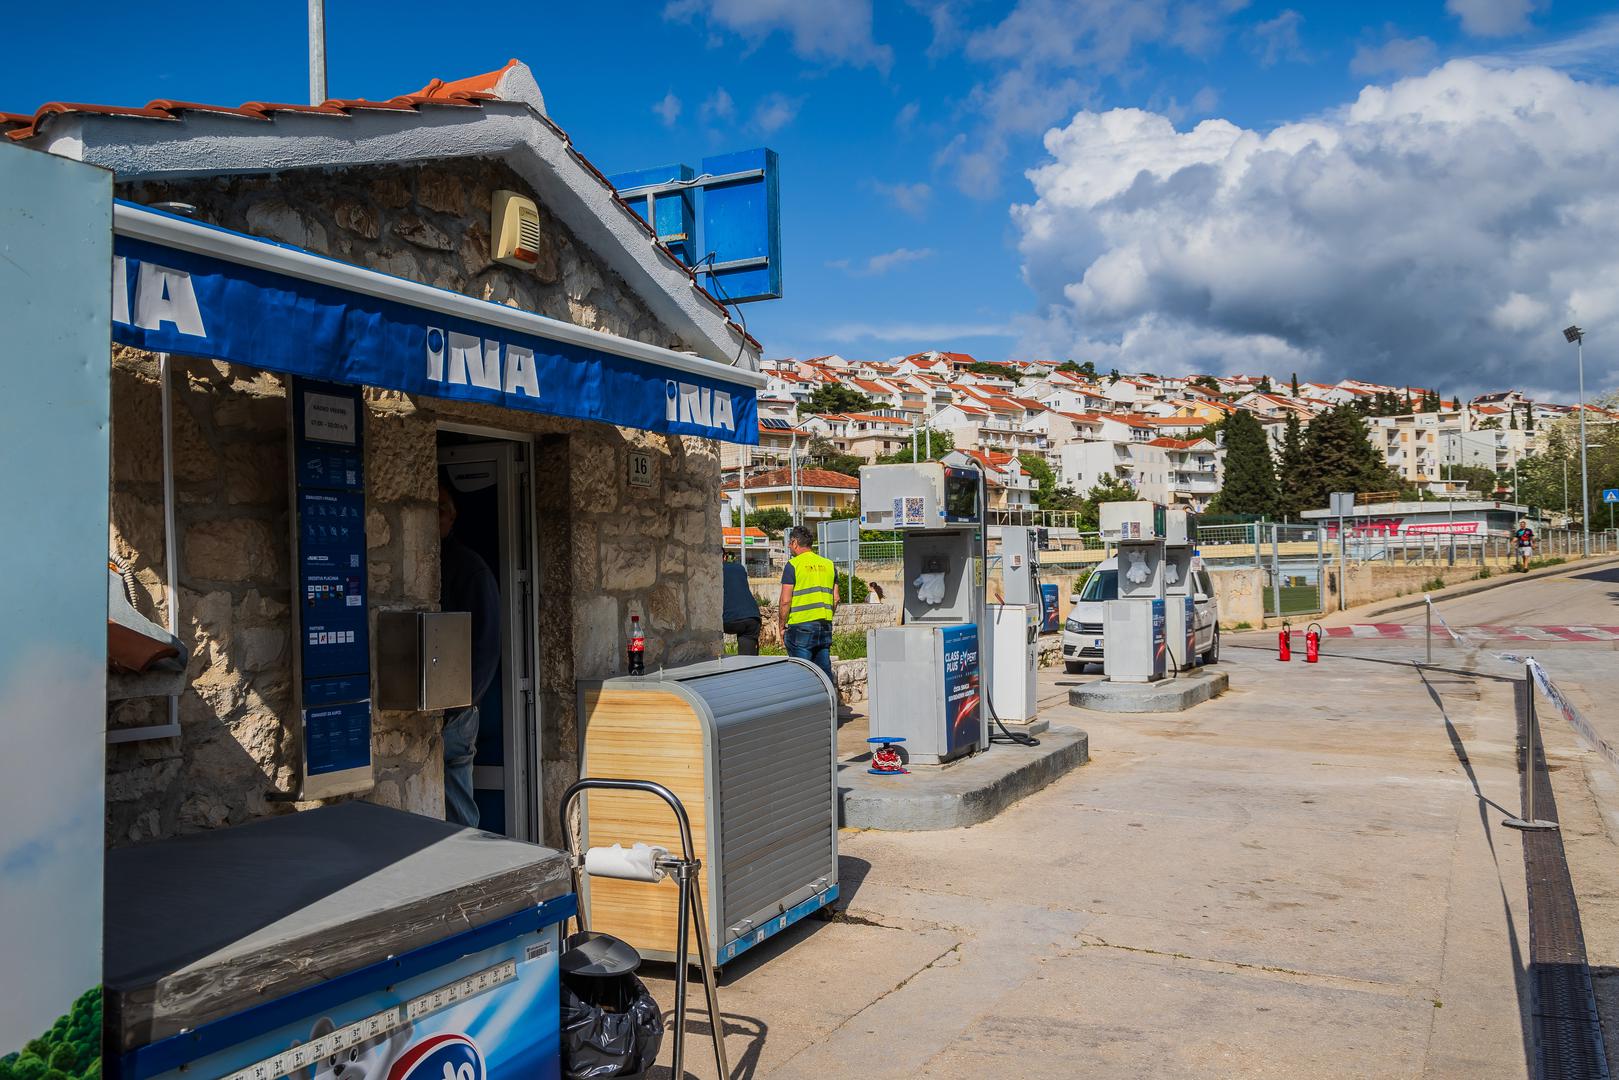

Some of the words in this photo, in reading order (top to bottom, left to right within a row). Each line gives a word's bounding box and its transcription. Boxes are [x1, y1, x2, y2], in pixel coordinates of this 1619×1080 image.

[634, 457, 647, 475] 16
[945, 651, 960, 663] CLASS
[946, 661, 958, 673] PLUS
